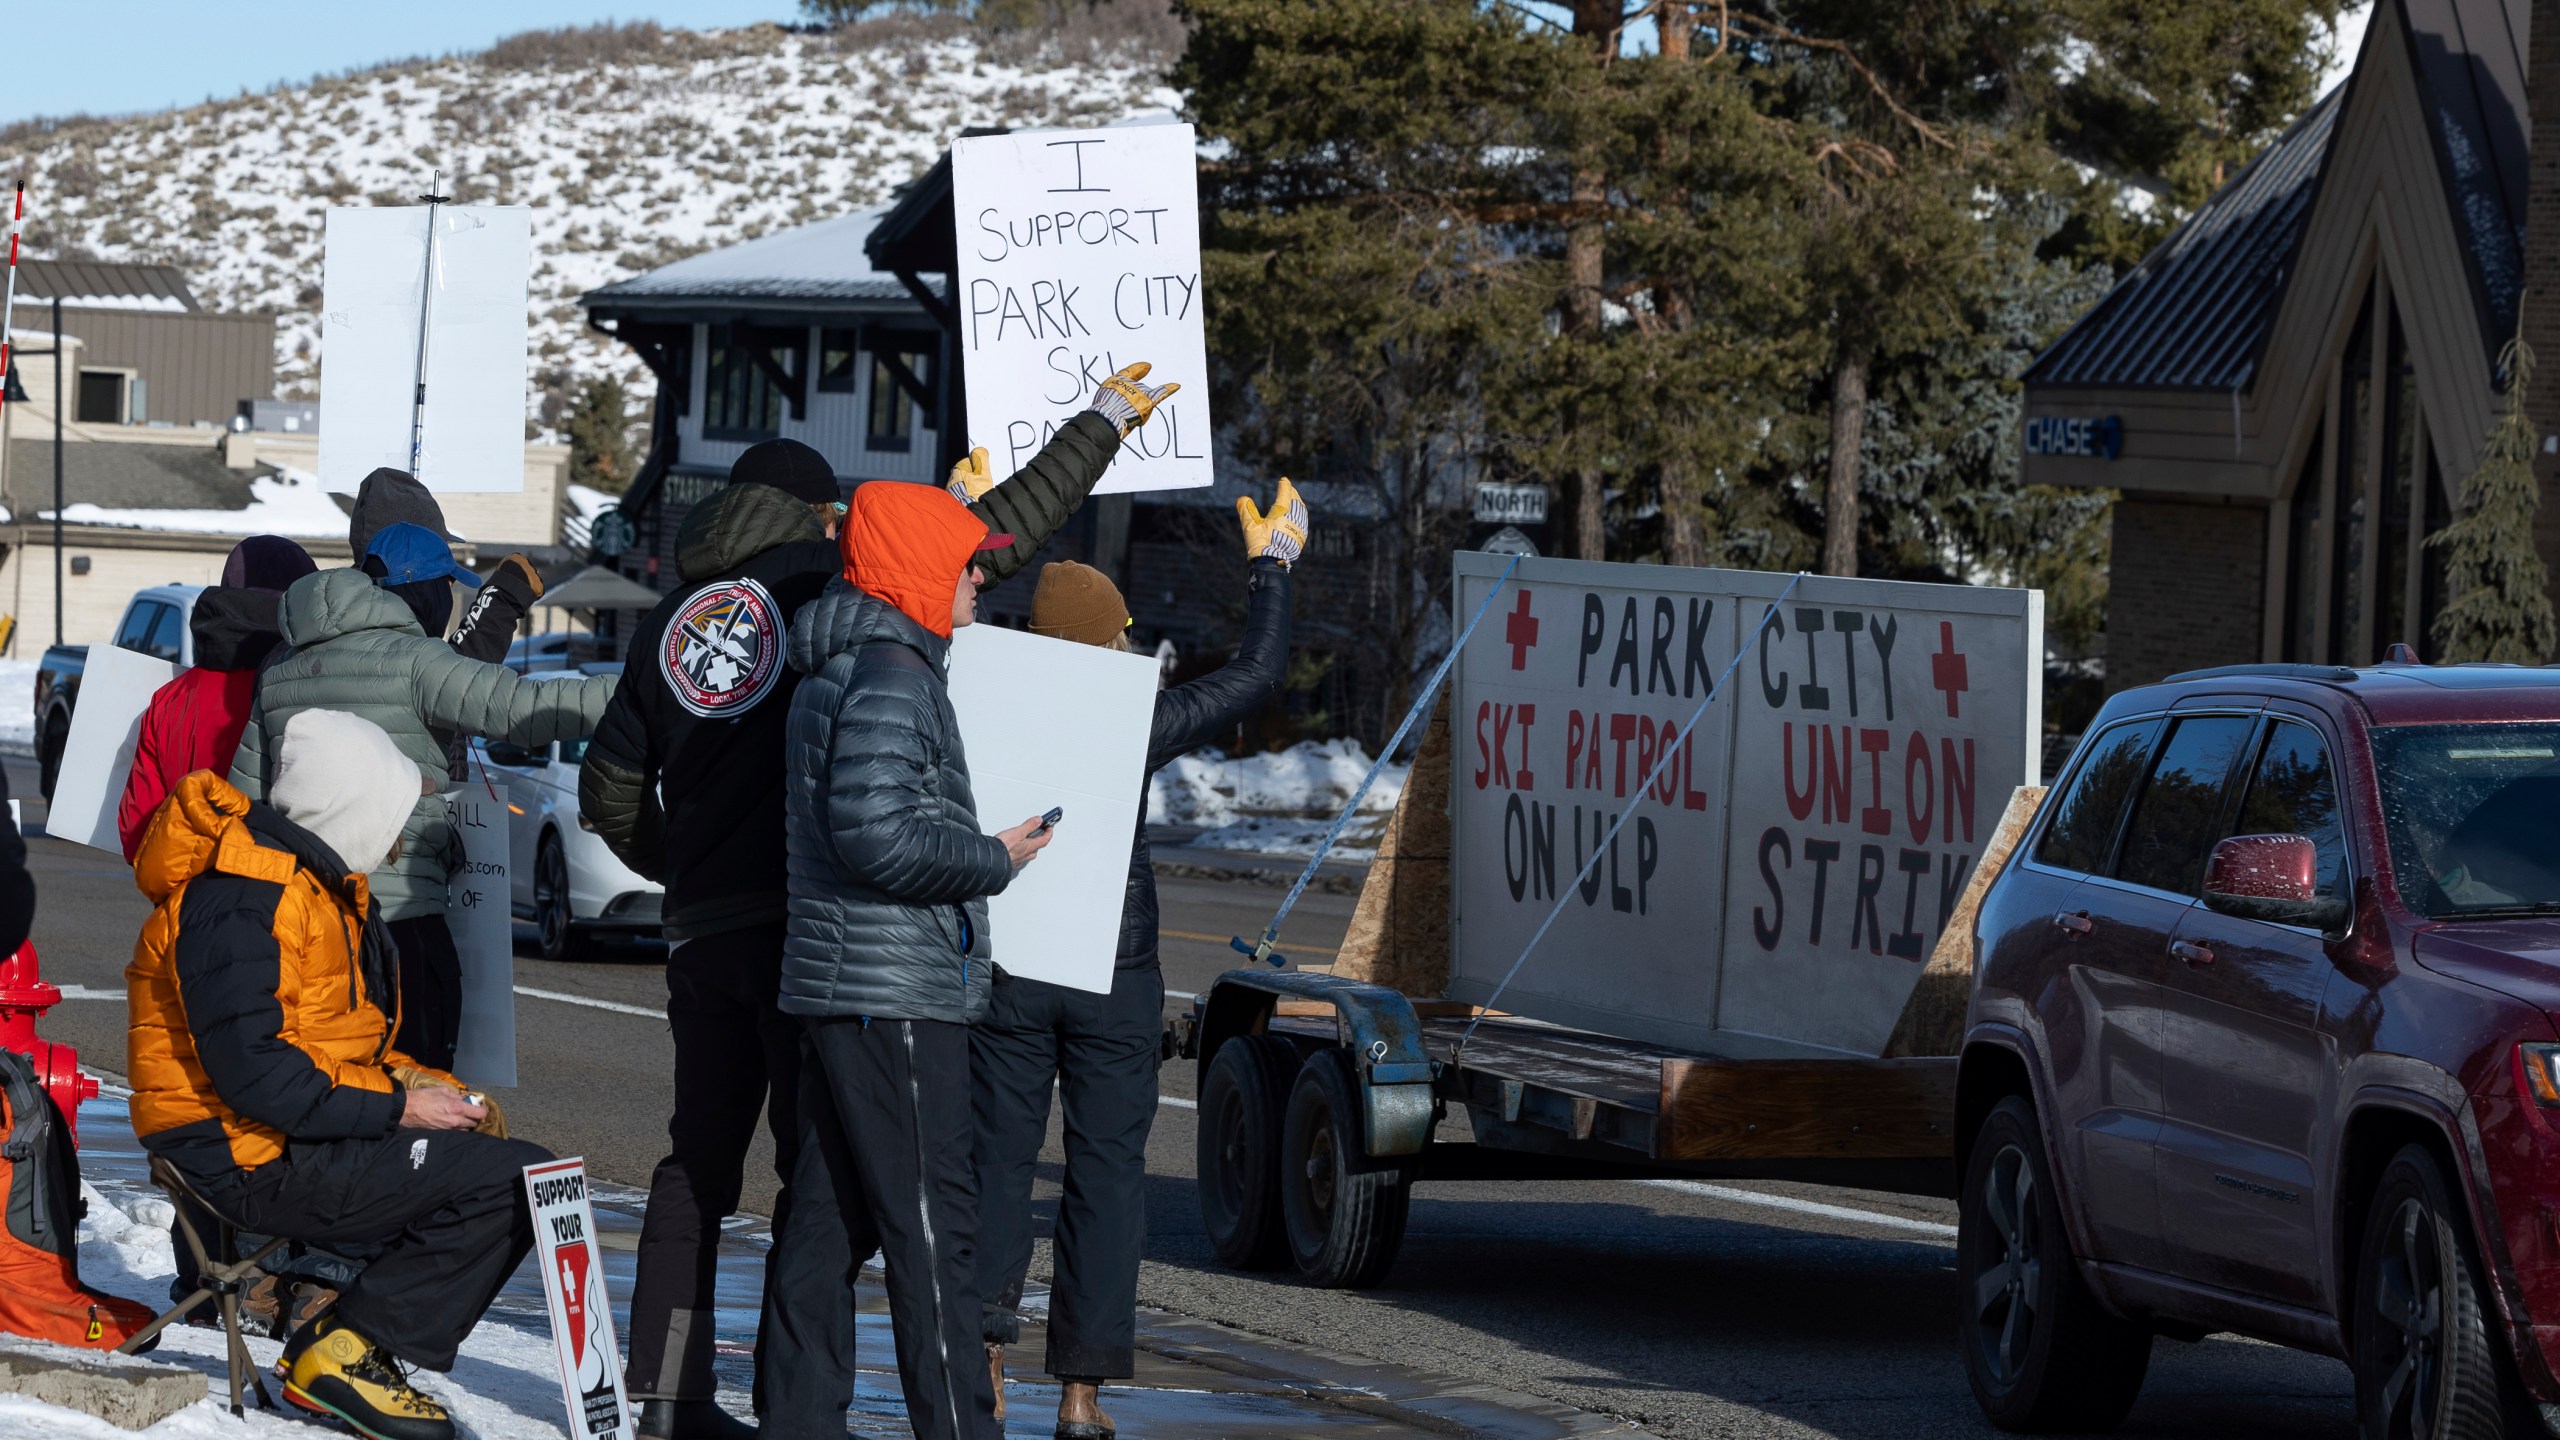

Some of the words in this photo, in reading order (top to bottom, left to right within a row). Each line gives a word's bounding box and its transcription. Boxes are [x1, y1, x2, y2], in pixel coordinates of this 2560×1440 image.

[1046, 139, 1111, 193] I
[977, 207, 1169, 262] SUPPORT
[971, 278, 1091, 350] PARK
[1114, 272, 1198, 330] CITY
[1008, 404, 1204, 474] PAOL
[2025, 417, 2093, 456] CHASE
[1481, 490, 1543, 513] NORTH
[750, 601, 769, 632] AMERICA
[1578, 592, 1715, 701] PARK
[1760, 603, 1898, 721] CITY
[710, 694, 732, 704] LOCAL
[733, 686, 748, 700] 7781
[1475, 700, 1536, 791] SKI
[1566, 709, 1708, 811] PATROL
[1783, 721, 1976, 845] UNION
[461, 889, 483, 909] OF
[1504, 792, 1555, 903] ON
[1574, 804, 1658, 916] ULP
[1753, 826, 1971, 962] STRIK
[533, 1174, 586, 1208] SUPPORT
[551, 1213, 584, 1242] YOUR
